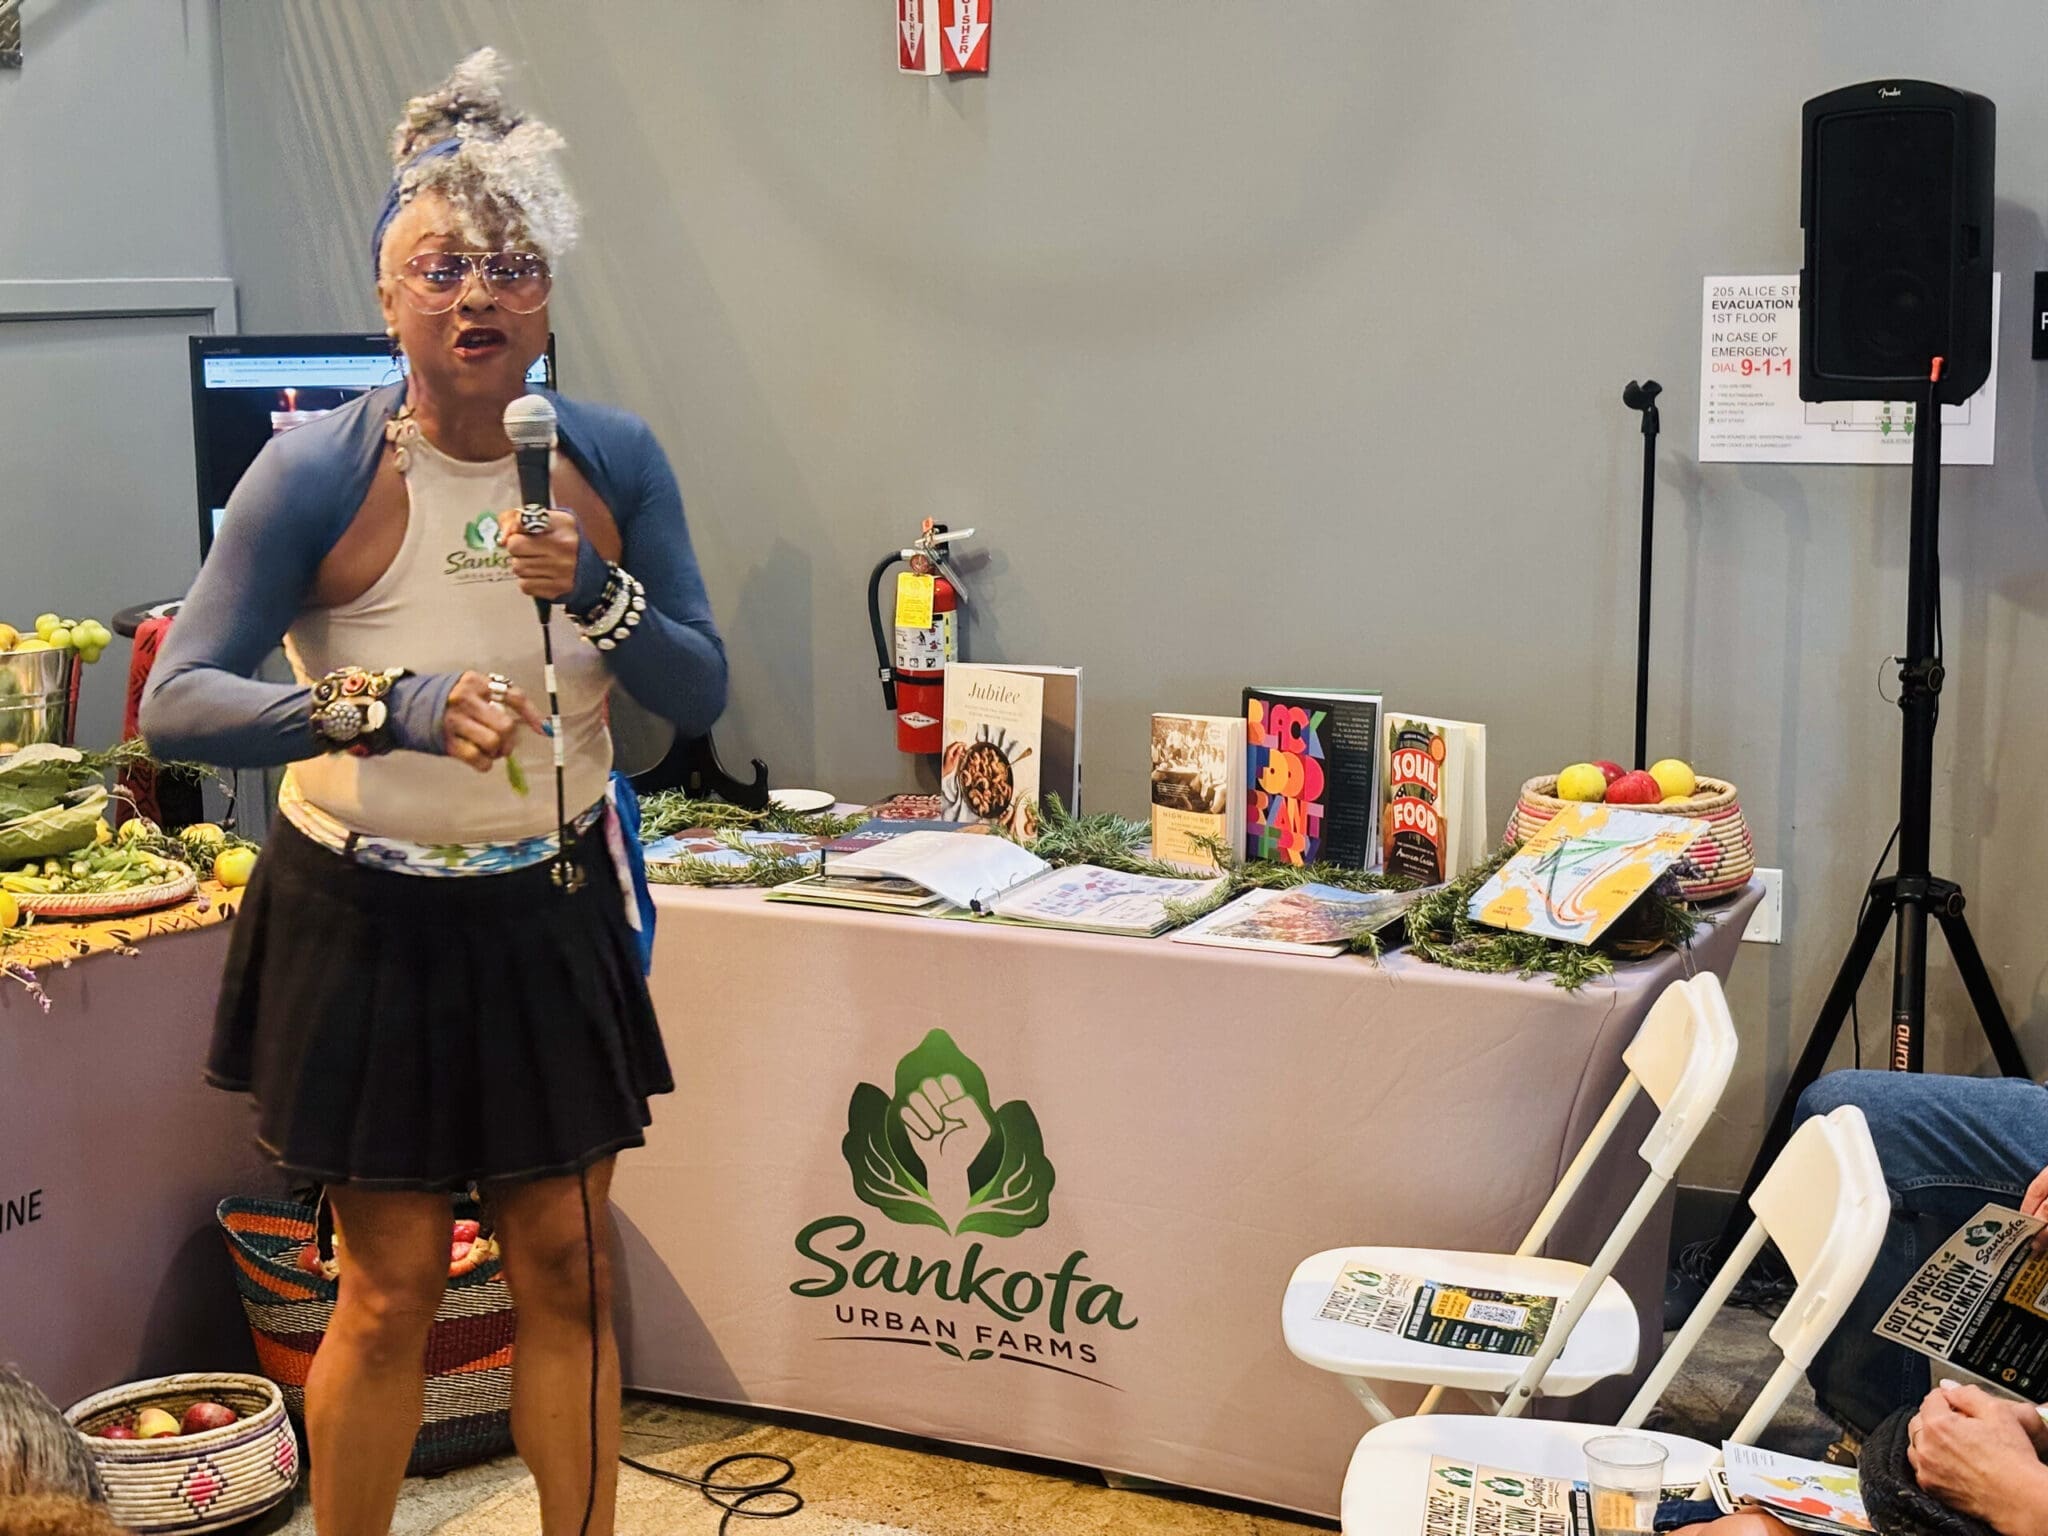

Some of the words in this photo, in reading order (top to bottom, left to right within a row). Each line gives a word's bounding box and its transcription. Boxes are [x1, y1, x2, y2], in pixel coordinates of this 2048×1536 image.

[1712, 300, 1793, 310] EVACUATION
[1713, 287, 1734, 297] 205
[1739, 286, 1776, 297] ALICE
[1781, 286, 1800, 297] ST
[1712, 313, 1732, 323] 1ST
[1736, 313, 1777, 323] FLOOR
[1711, 347, 1788, 357] EMERGENCY
[1712, 333, 1723, 343] IN
[1726, 333, 1759, 343] CASE
[1762, 332, 1778, 343] OF
[1712, 363, 1737, 373] DIAL
[1741, 359, 1791, 376] 9-1-1
[444, 551, 512, 574] Sanko
[968, 682, 1021, 705] Jubilee
[1247, 698, 1328, 760] BLACK
[1247, 745, 1325, 802] FOOD
[1393, 753, 1437, 789] SOUL
[1393, 801, 1437, 836] FOOD
[1896, 1024, 1910, 1072] aura
[1975, 1218, 2026, 1265] Sankofa
[790, 1216, 1139, 1334] Sankofa
[1884, 1307, 1912, 1334] GOT
[1901, 1263, 1944, 1309] SPACE?
[1902, 1304, 1944, 1343] LET'S
[1930, 1259, 1974, 1303] GROW
[1925, 1338, 1945, 1352] A
[1935, 1269, 1993, 1341] MOVEMENT!
[836, 1304, 956, 1339] URBAN
[976, 1325, 1097, 1364] FARMS
